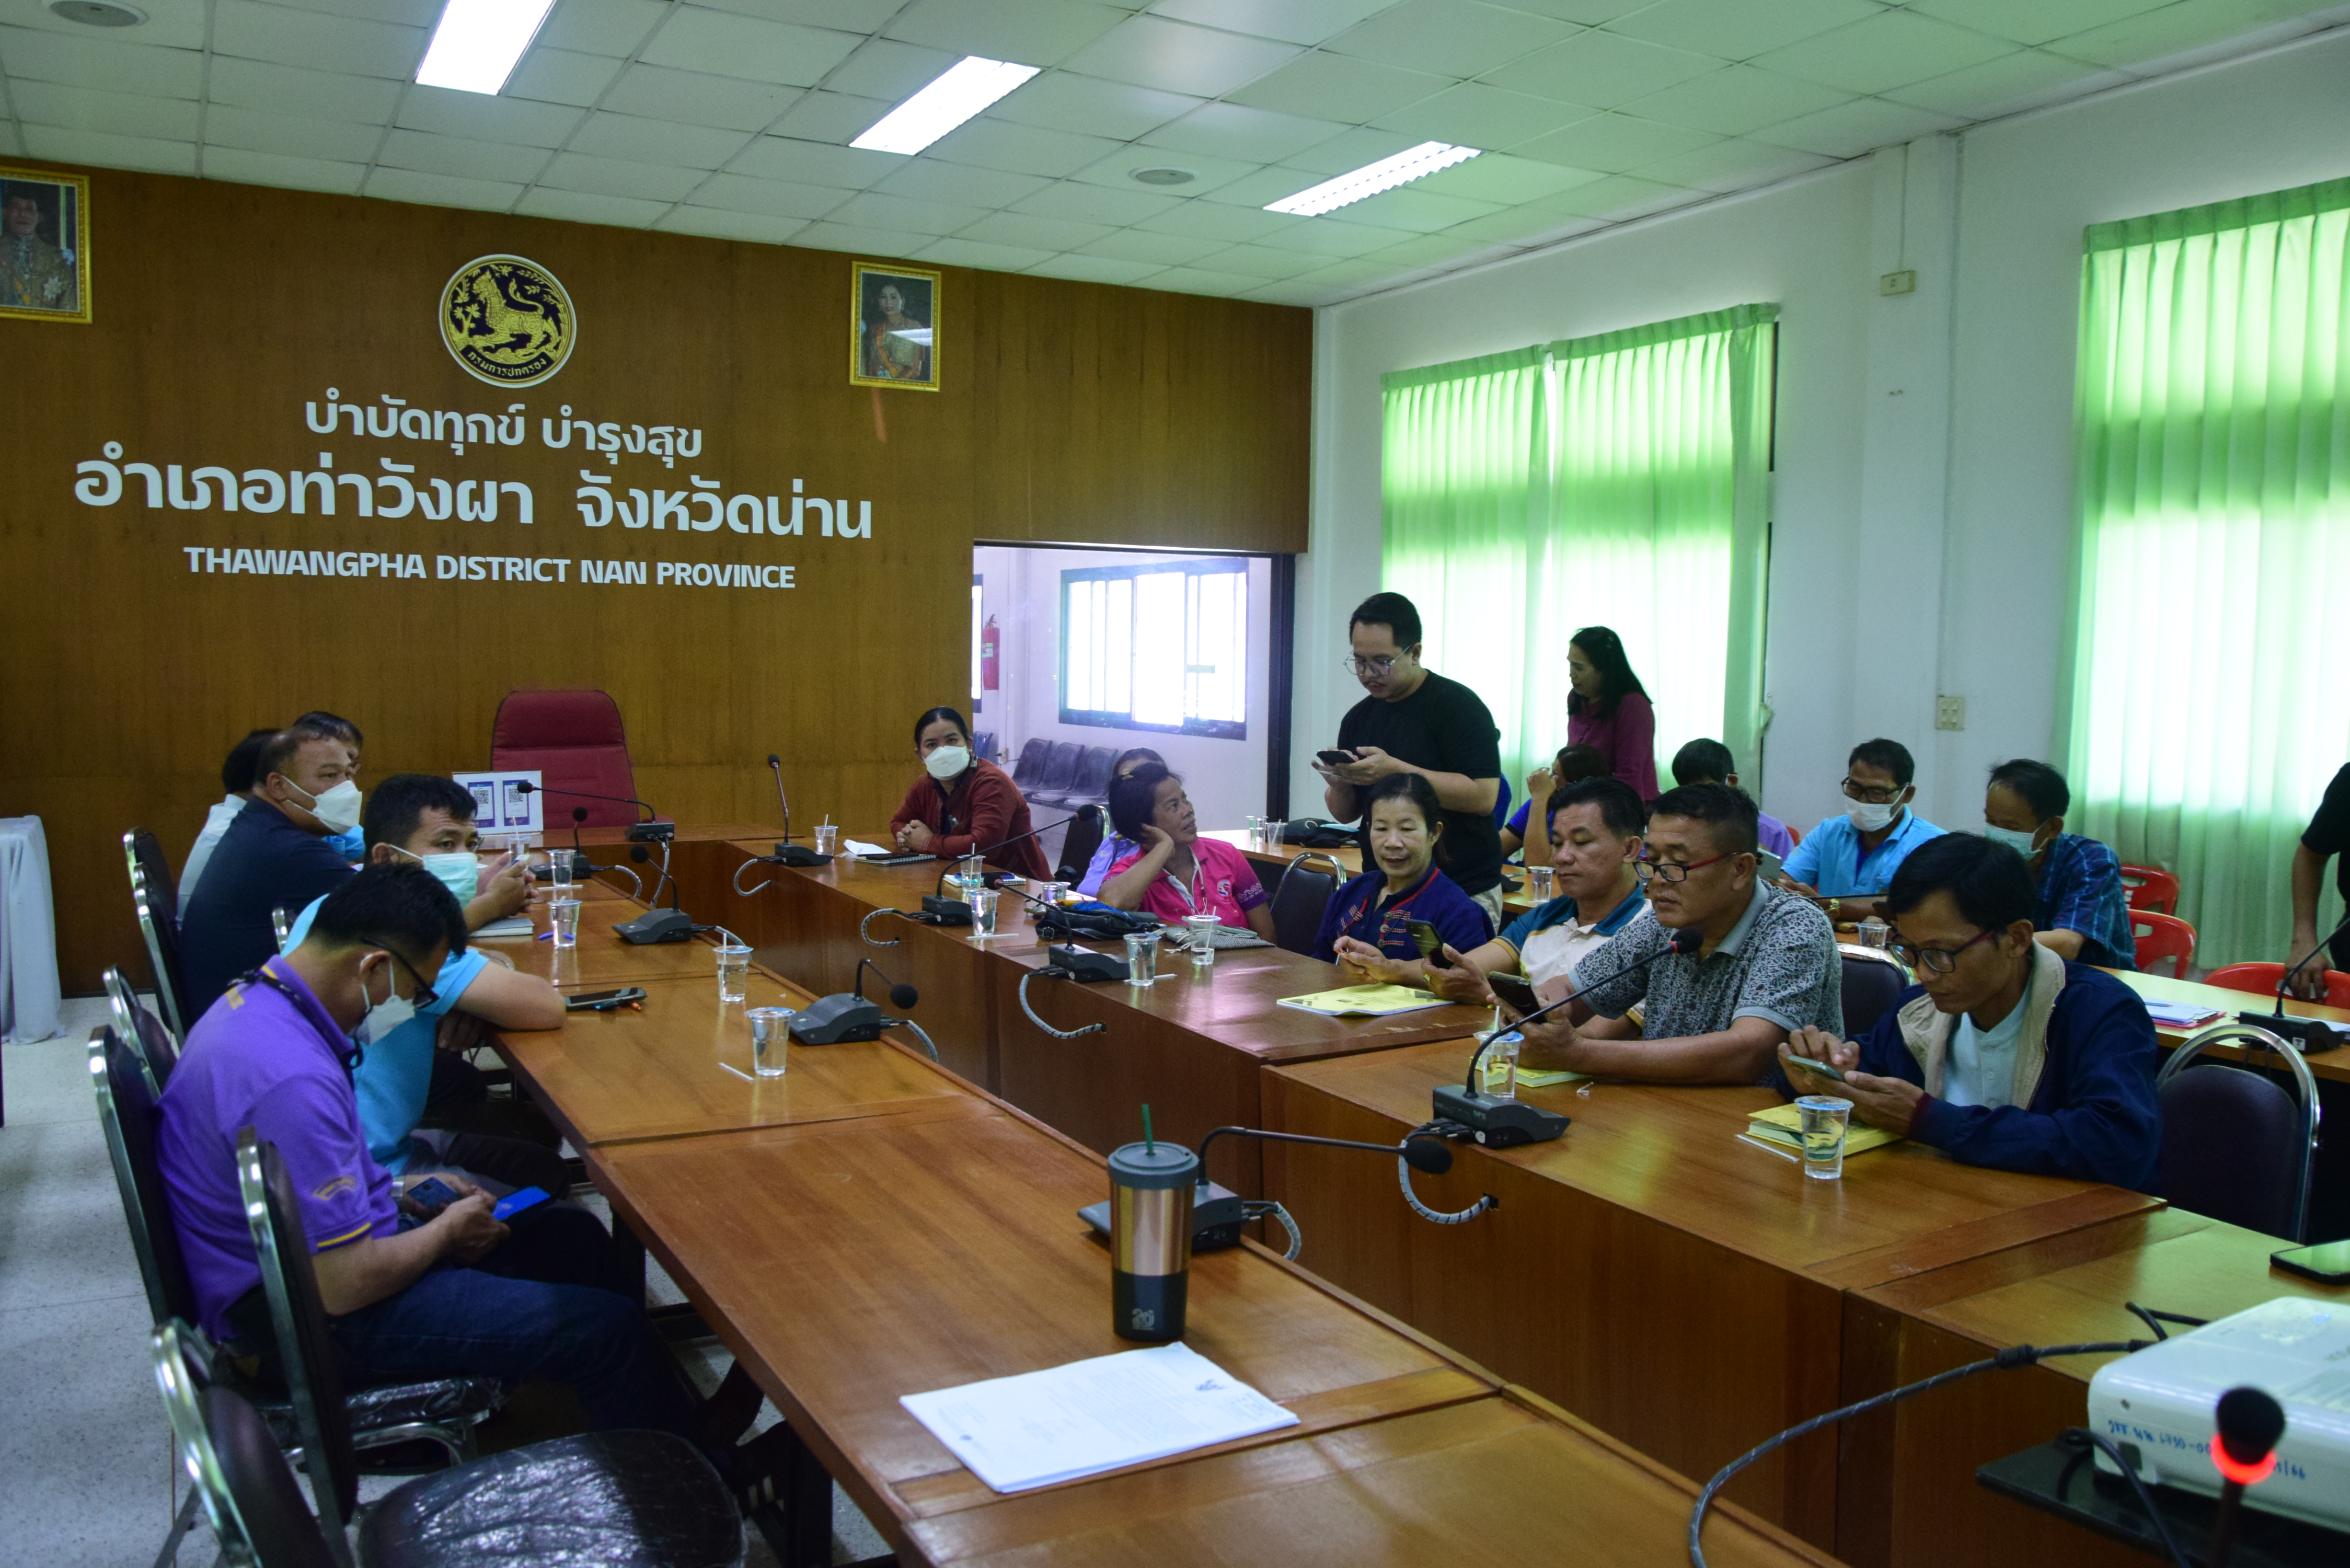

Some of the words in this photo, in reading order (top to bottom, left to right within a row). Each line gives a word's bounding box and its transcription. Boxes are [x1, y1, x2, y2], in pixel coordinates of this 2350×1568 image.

[305, 387, 526, 456] บำบัดทุกข์
[542, 404, 702, 469] บำรุงสุข
[74, 441, 534, 524] อำเภอท่าวังผา
[576, 469, 871, 539] จังหวัดน่าน
[183, 547, 427, 579] THAWANGPHA
[436, 555, 571, 583] DISTRICT
[580, 559, 647, 585] NAN
[656, 562, 796, 589] PROVINCE
